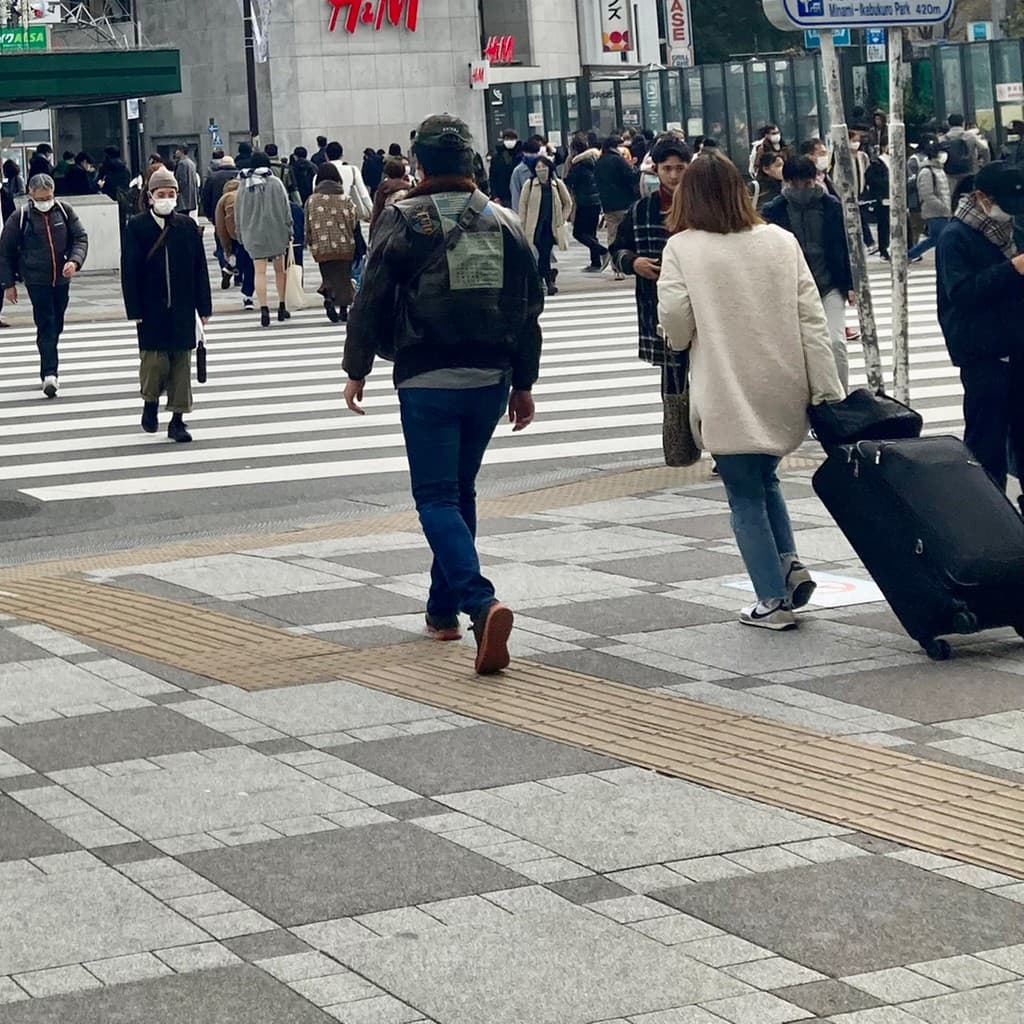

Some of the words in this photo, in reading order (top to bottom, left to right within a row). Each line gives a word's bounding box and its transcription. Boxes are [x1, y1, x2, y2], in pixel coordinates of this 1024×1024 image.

[895, 2, 910, 16] Park
[915, 5, 941, 16] 420m
[484, 35, 515, 63] H&M
